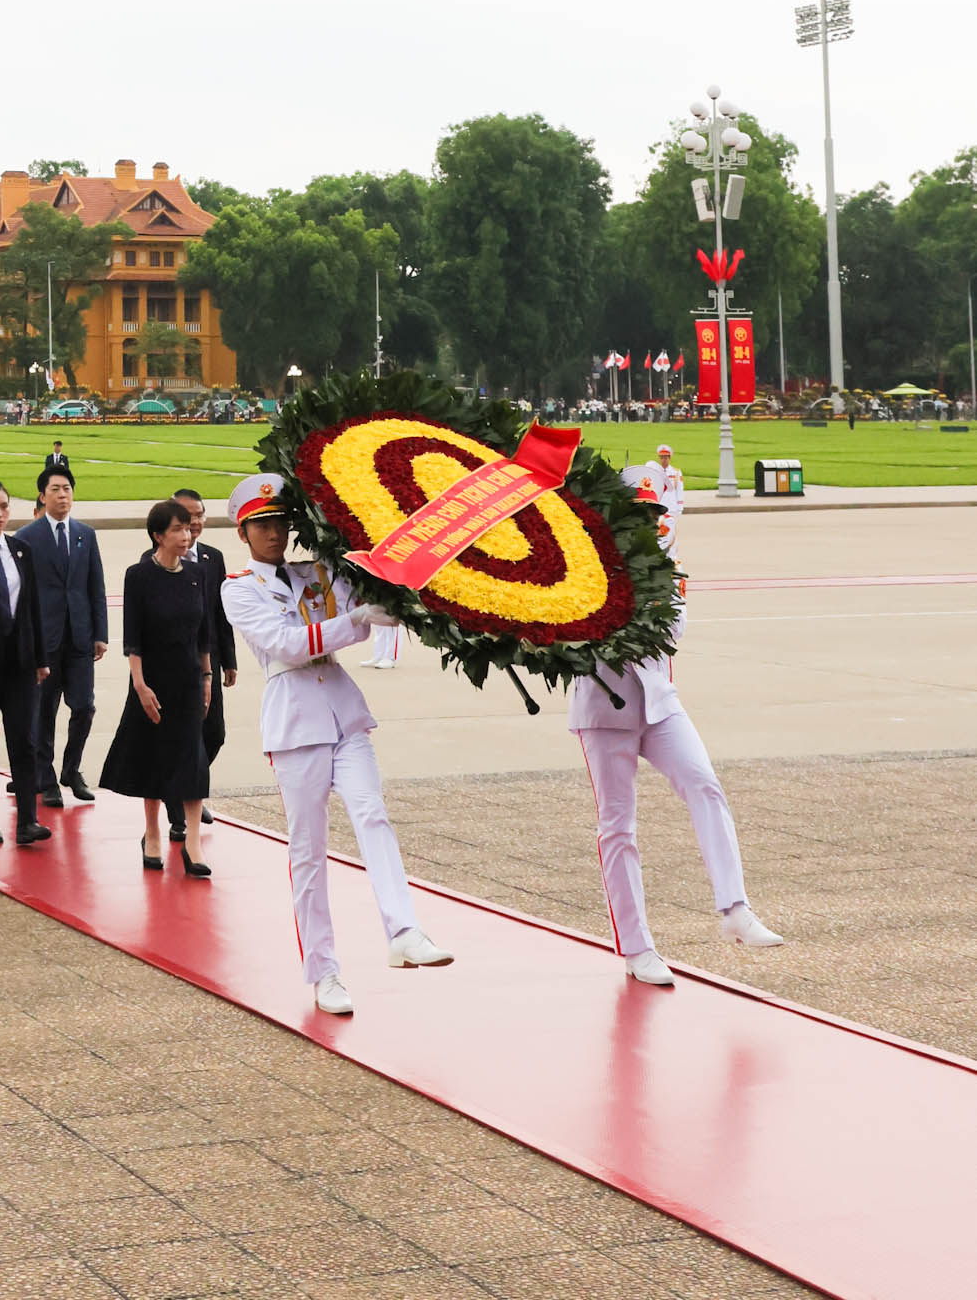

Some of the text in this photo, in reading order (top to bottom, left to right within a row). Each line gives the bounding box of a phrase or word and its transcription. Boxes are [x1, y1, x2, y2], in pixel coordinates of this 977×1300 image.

[383, 534, 422, 563] KÍNH
[407, 515, 450, 542] VIẾNG
[436, 497, 469, 520] CHỦ
